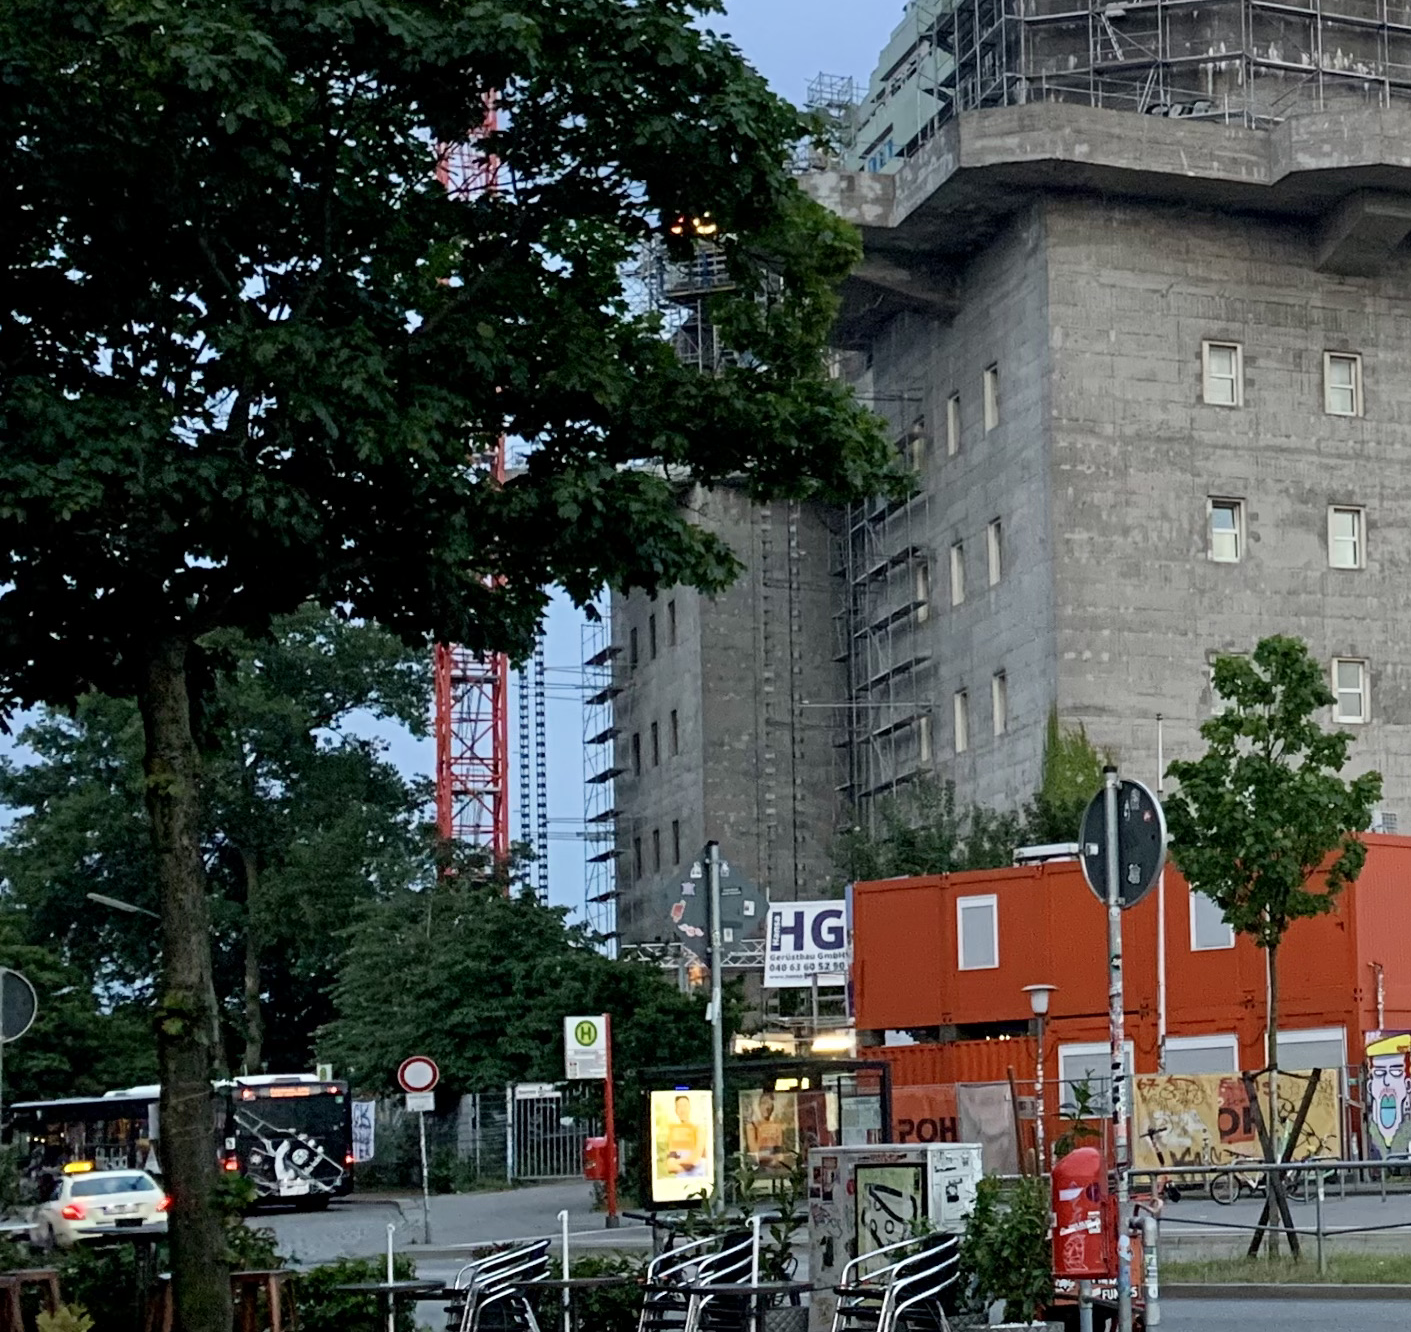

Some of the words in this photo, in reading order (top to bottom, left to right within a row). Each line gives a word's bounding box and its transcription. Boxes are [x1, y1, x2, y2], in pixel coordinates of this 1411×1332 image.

[771, 909, 845, 952] HG
[772, 915, 781, 946] Hansa
[769, 953, 816, 961] Gerüstbau
[769, 963, 787, 972] 040
[789, 963, 801, 972] 63
[803, 962, 816, 971] 60
[898, 1116, 959, 1144] POH
